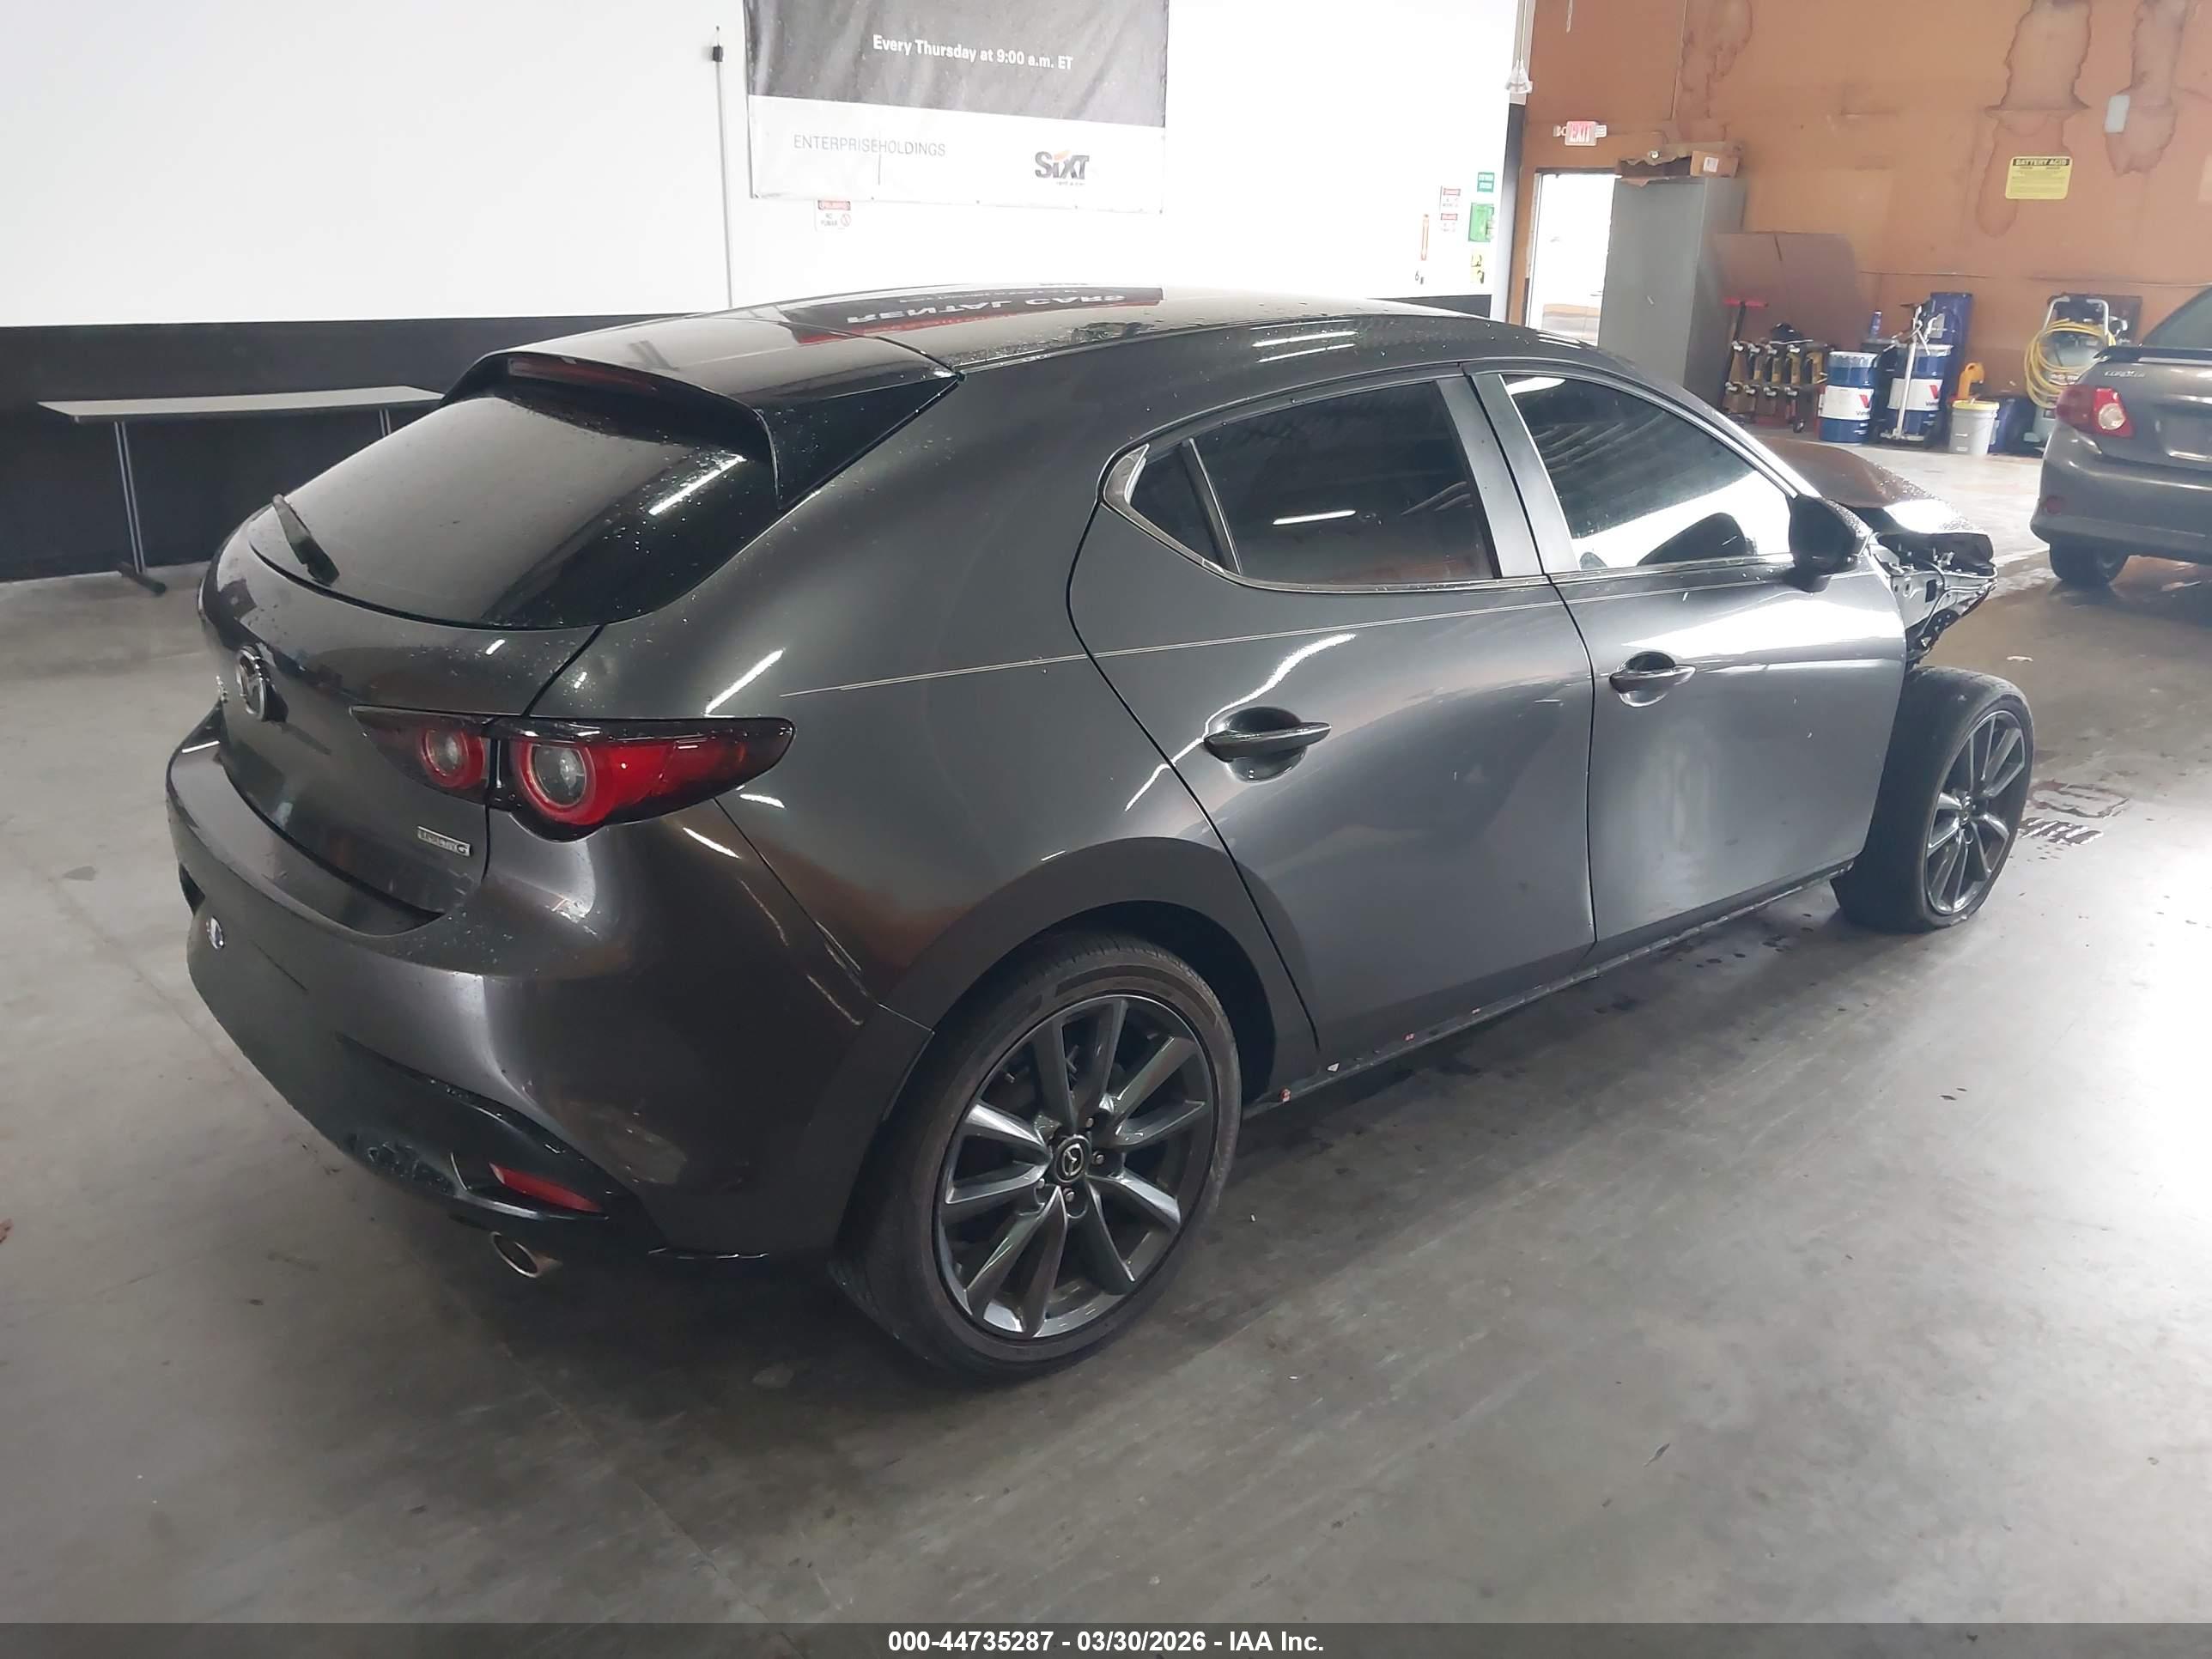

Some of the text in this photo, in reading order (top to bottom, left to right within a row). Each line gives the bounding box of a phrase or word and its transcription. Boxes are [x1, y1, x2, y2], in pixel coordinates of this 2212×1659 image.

[872, 34, 1073, 70] Every Thursday at 9:00 a.m. ET
